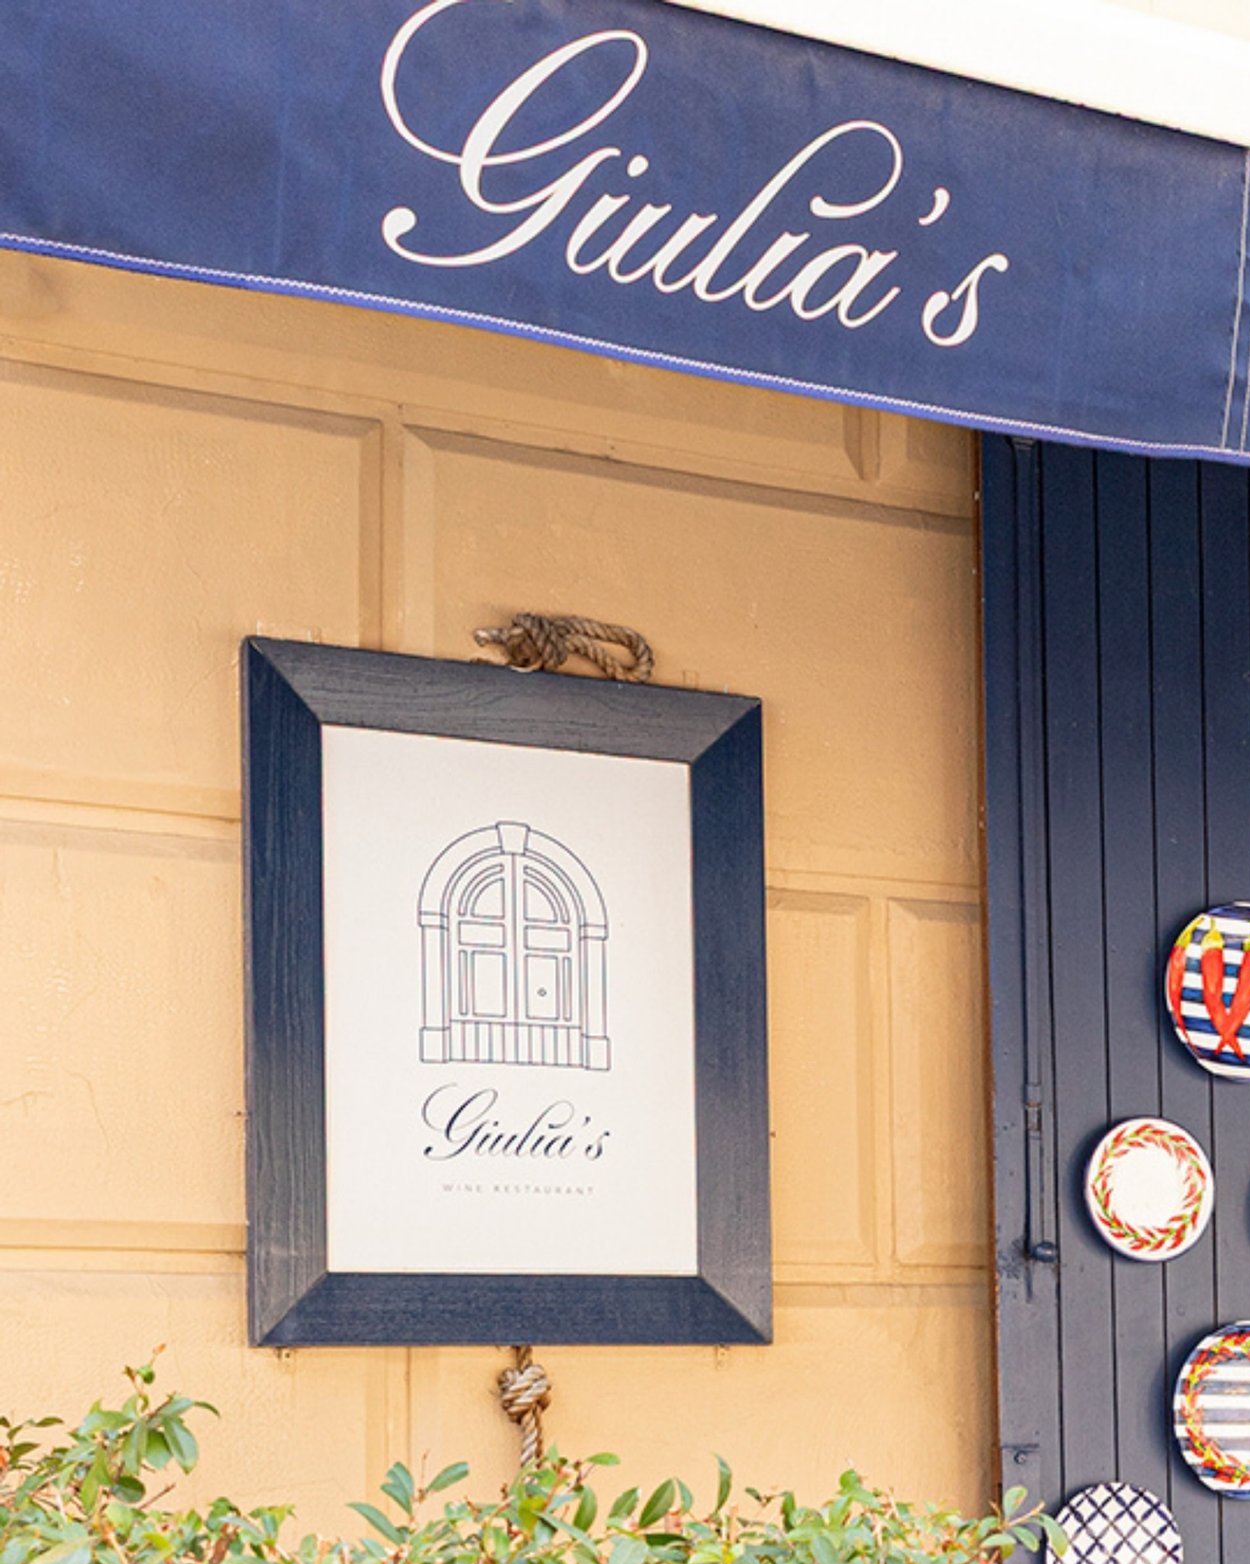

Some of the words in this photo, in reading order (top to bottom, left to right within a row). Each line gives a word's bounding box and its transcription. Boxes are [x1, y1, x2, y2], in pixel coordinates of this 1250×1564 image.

[381, 0, 1009, 347] Giulia's
[421, 1082, 611, 1161] Giulia's
[441, 1183, 483, 1193] WINE
[493, 1184, 594, 1195] RESTAURANT
